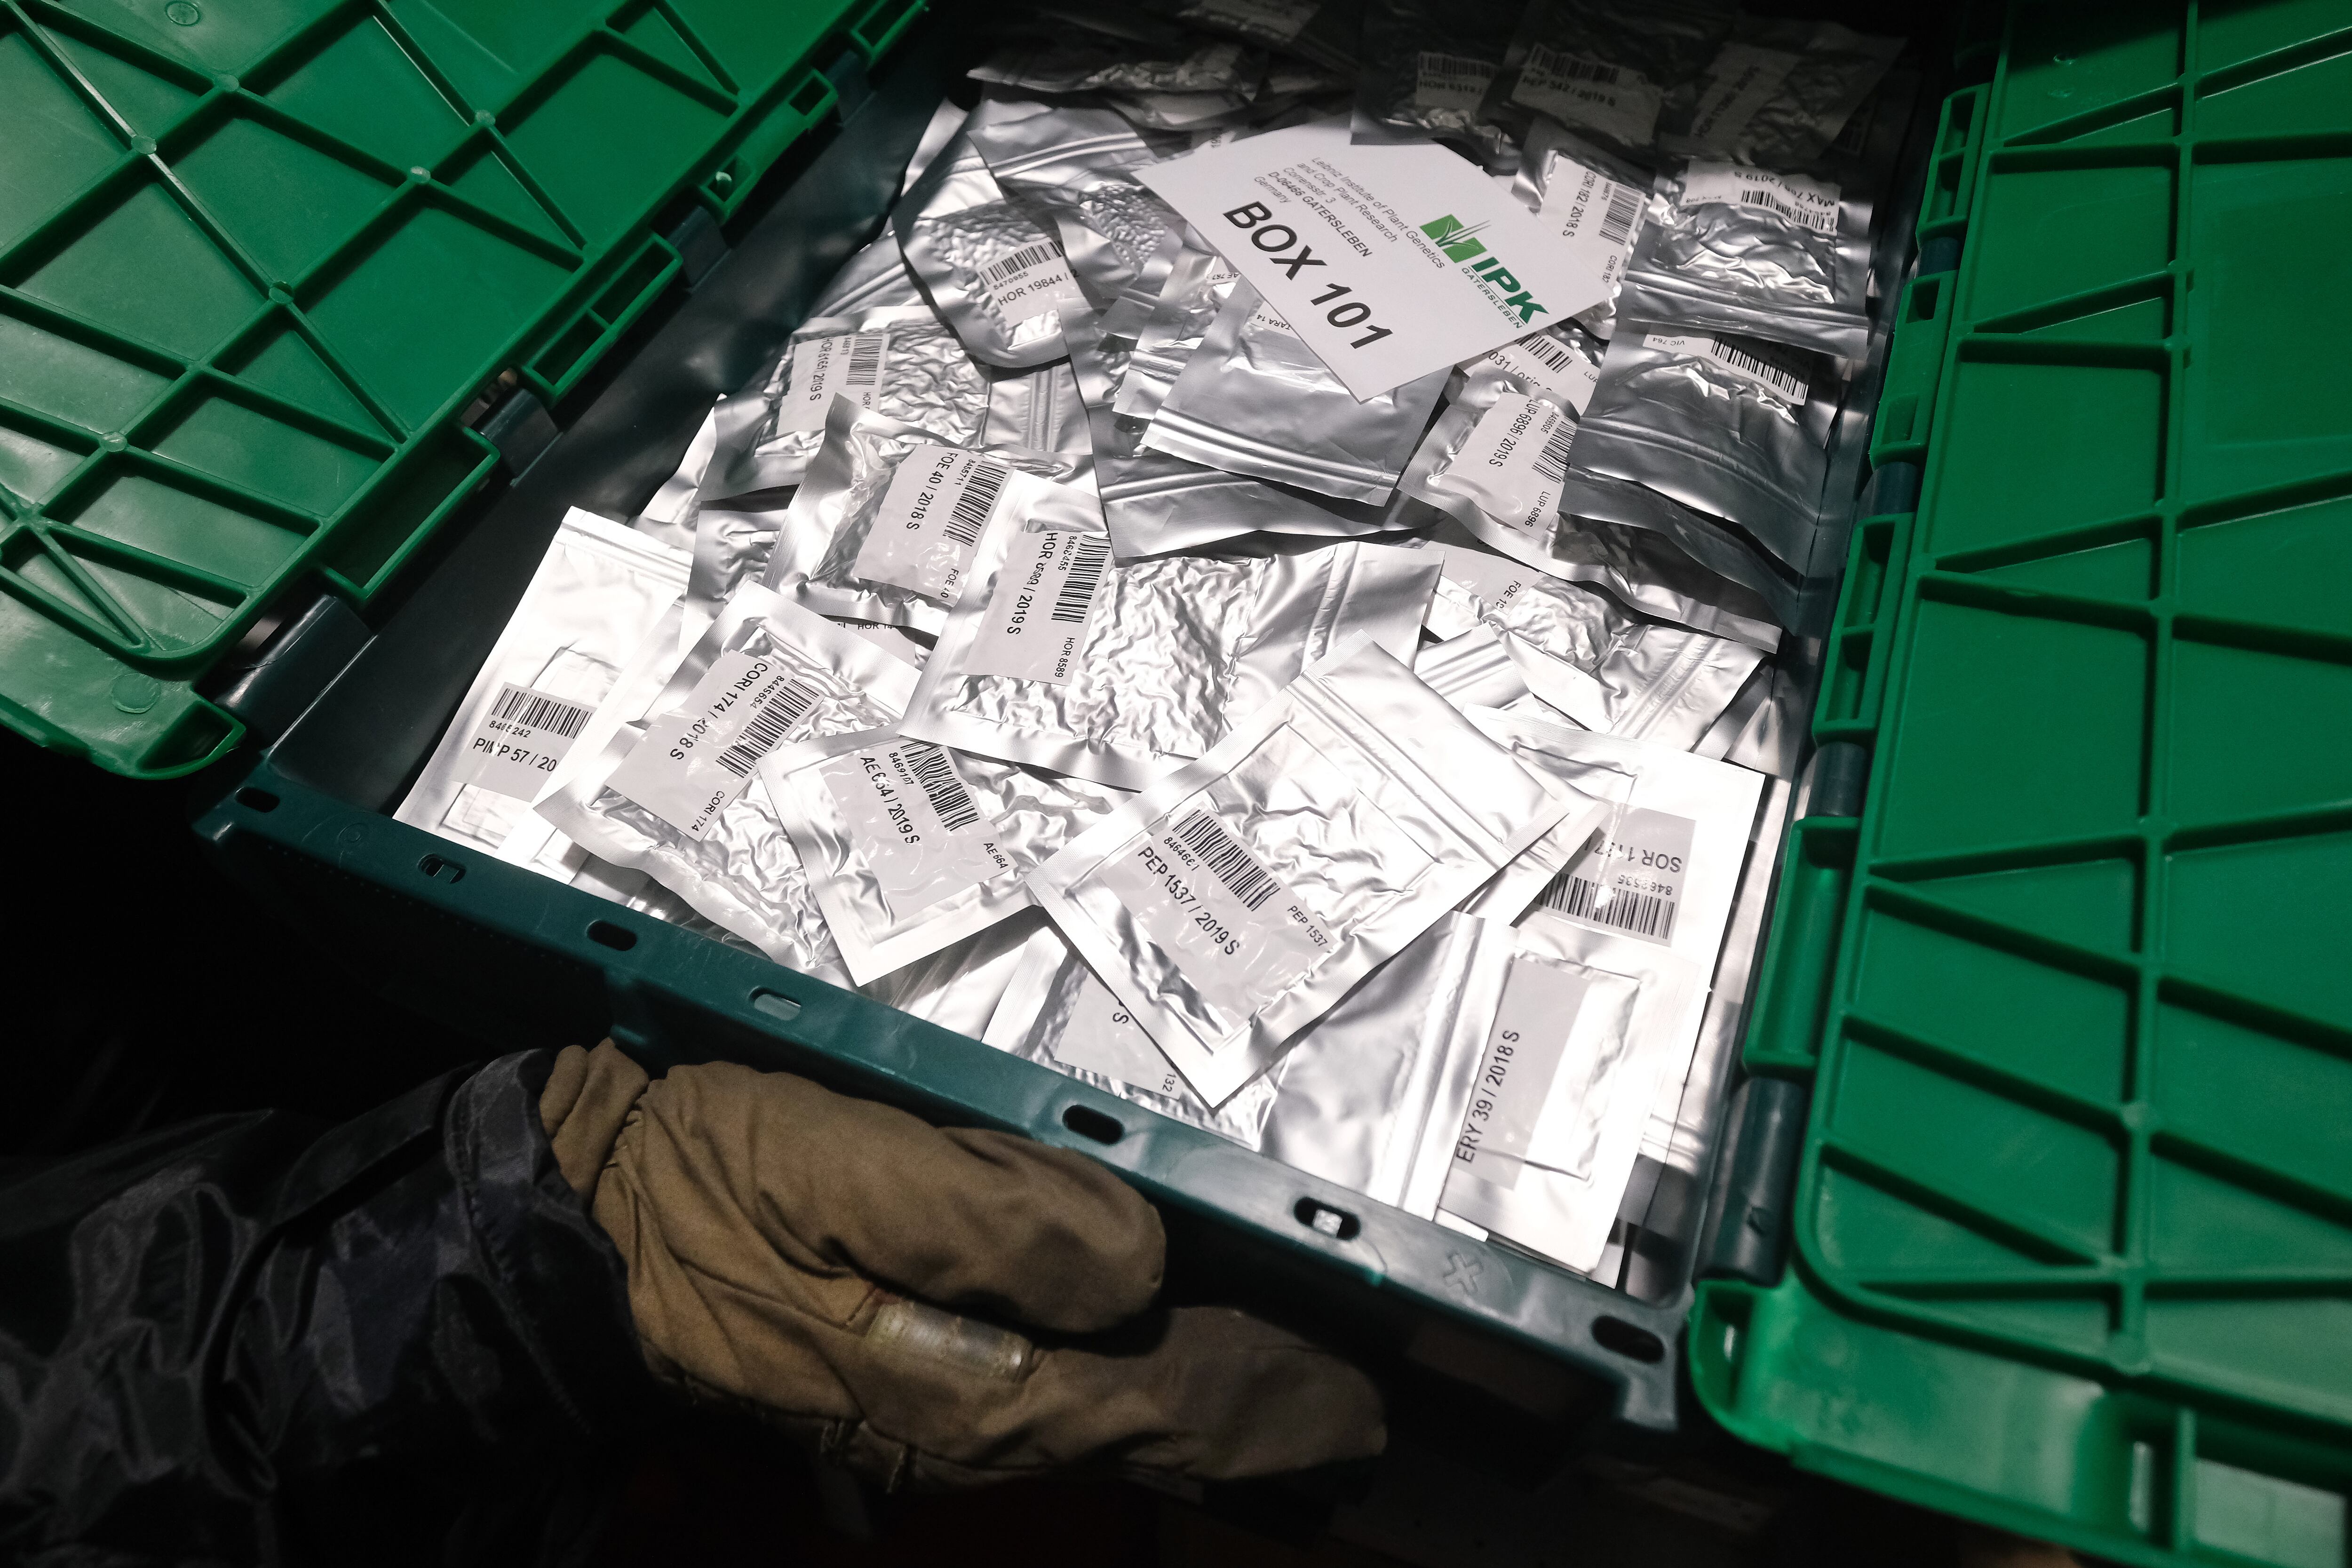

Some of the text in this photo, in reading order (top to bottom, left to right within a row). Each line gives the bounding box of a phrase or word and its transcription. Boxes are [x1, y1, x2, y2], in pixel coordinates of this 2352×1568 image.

[1254, 176, 1291, 203] Germany
[1582, 171, 1597, 188] CORI
[1297, 163, 1398, 242] and Crop Plant Research
[1576, 188, 1590, 202] 182
[1807, 192, 1836, 207] MAX
[1268, 171, 1373, 257] D-06466 GATERSLEBEN
[1340, 176, 1375, 201] Institute
[1382, 209, 1409, 231] Plant
[1406, 231, 1445, 268] Genetics
[1566, 206, 1584, 229] 2018
[1223, 201, 1393, 349] BOX 101
[1605, 255, 1617, 271] CORI
[993, 271, 1029, 290] 8470955
[998, 287, 1027, 306] HOR
[1028, 274, 1063, 291] 19844
[1064, 272, 1069, 280] /
[1470, 256, 1549, 324] IPK
[1462, 268, 1523, 329] GATERSLEBEN
[1268, 318, 1291, 330] TARA
[819, 336, 833, 352] HOR
[810, 373, 825, 392] 2019
[862, 392, 871, 406] HOR
[1525, 399, 1540, 414] LUP
[1510, 414, 1532, 435] 6896
[1541, 412, 1559, 434] 8459505
[936, 452, 959, 470] FOE
[1494, 438, 1517, 460] 2019
[954, 459, 976, 489] 8455711
[1489, 459, 1503, 467] S
[929, 471, 944, 484] 40
[911, 492, 934, 519] 2018
[1525, 491, 1551, 527] LUP 6896
[1038, 529, 1058, 559] HOR
[945, 568, 959, 586] FOE
[1503, 580, 1521, 598] FOE
[1011, 595, 1033, 624] 2019
[1007, 626, 1021, 635] S
[1054, 637, 1075, 677] HOR 8589
[670, 663, 768, 760] CORI 174 / 2018 S
[510, 748, 530, 763] 57
[528, 754, 539, 765] /
[537, 756, 557, 772] 20
[691, 791, 725, 832] CORI 174
[860, 757, 881, 774] AE
[888, 803, 913, 834] 2019
[904, 835, 920, 844] S
[983, 843, 1009, 869] AE 664
[1642, 849, 1682, 873] SOR
[1137, 846, 1168, 875] PEP
[1164, 874, 1196, 905] 1537
[1194, 912, 1229, 944] 2019
[1224, 939, 1240, 955] S
[1287, 905, 1328, 947] PEP 1537
[1112, 1012, 1129, 1024] S
[1162, 1074, 1176, 1092] 132
[1454, 1030, 1519, 1163] ERY 39 / 2018 S
